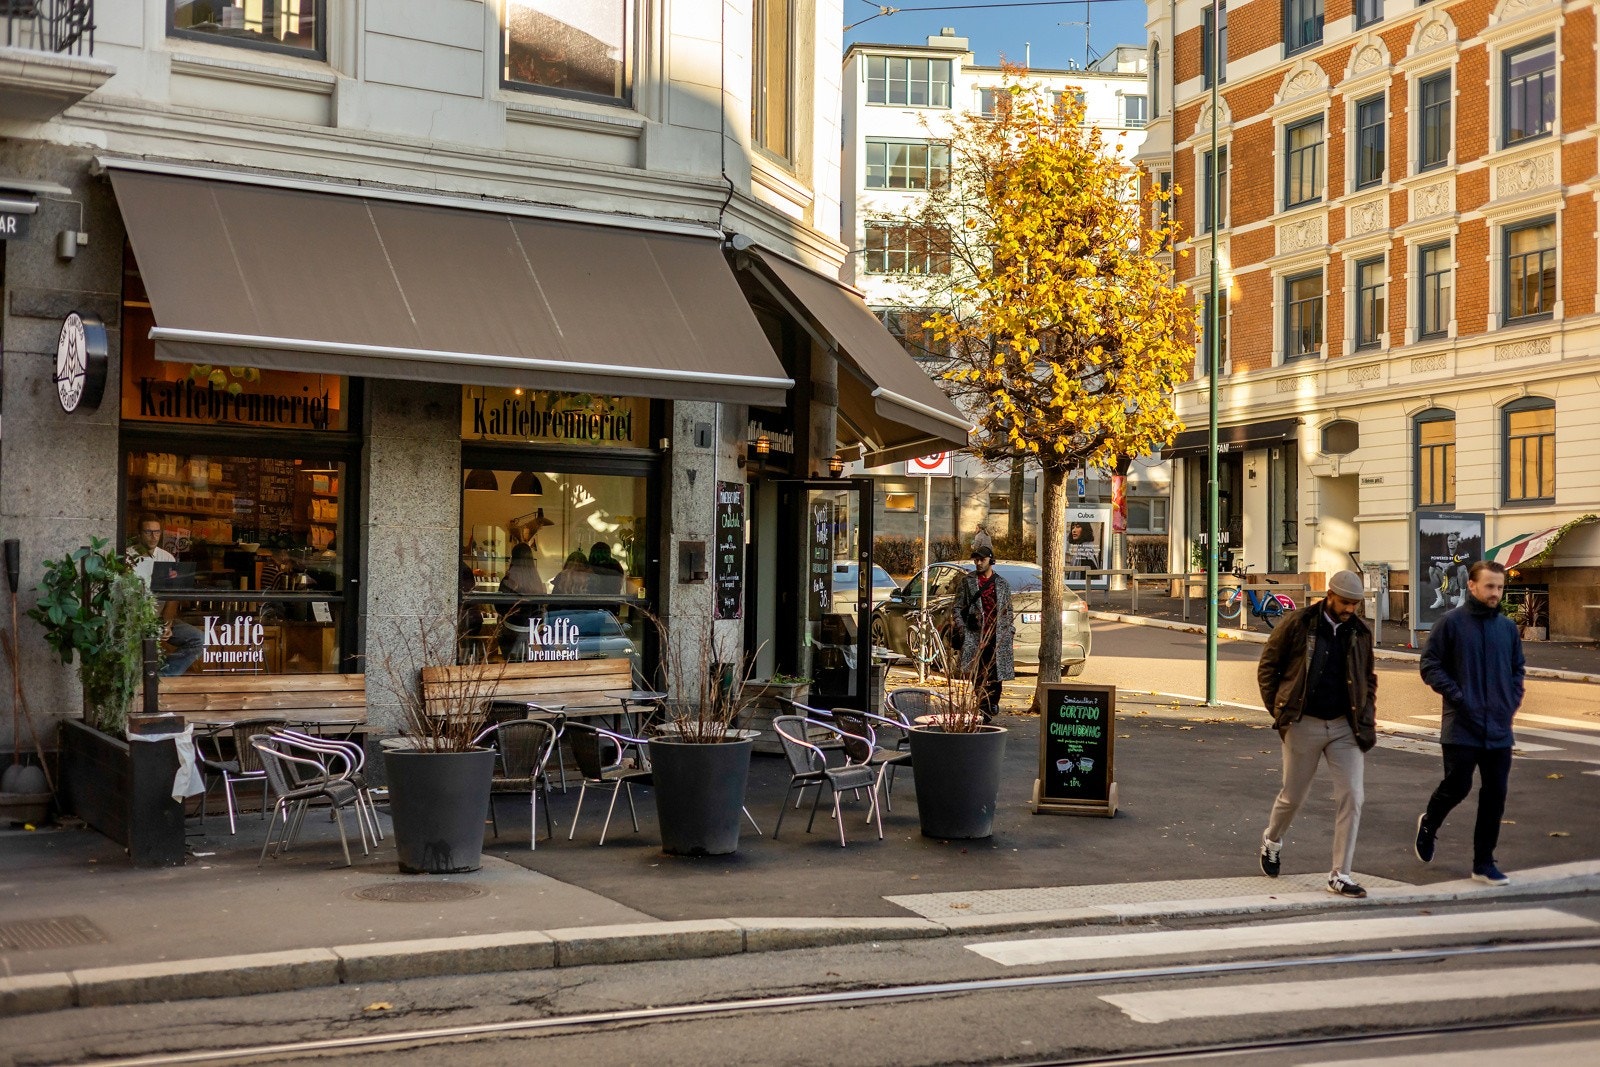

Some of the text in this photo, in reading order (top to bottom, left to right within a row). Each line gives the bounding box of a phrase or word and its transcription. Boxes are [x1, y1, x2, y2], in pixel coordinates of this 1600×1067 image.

[140, 376, 330, 425] Kaffebrenneriet
[473, 397, 634, 441] Kaffebrenneriet
[203, 615, 264, 646] Kaffe
[528, 617, 580, 646] Kaffe
[203, 647, 264, 663] brenneriet
[528, 646, 579, 661] brenneriet
[1060, 705, 1099, 720] CORTADO
[1050, 722, 1101, 738] CHIAPUDDING
